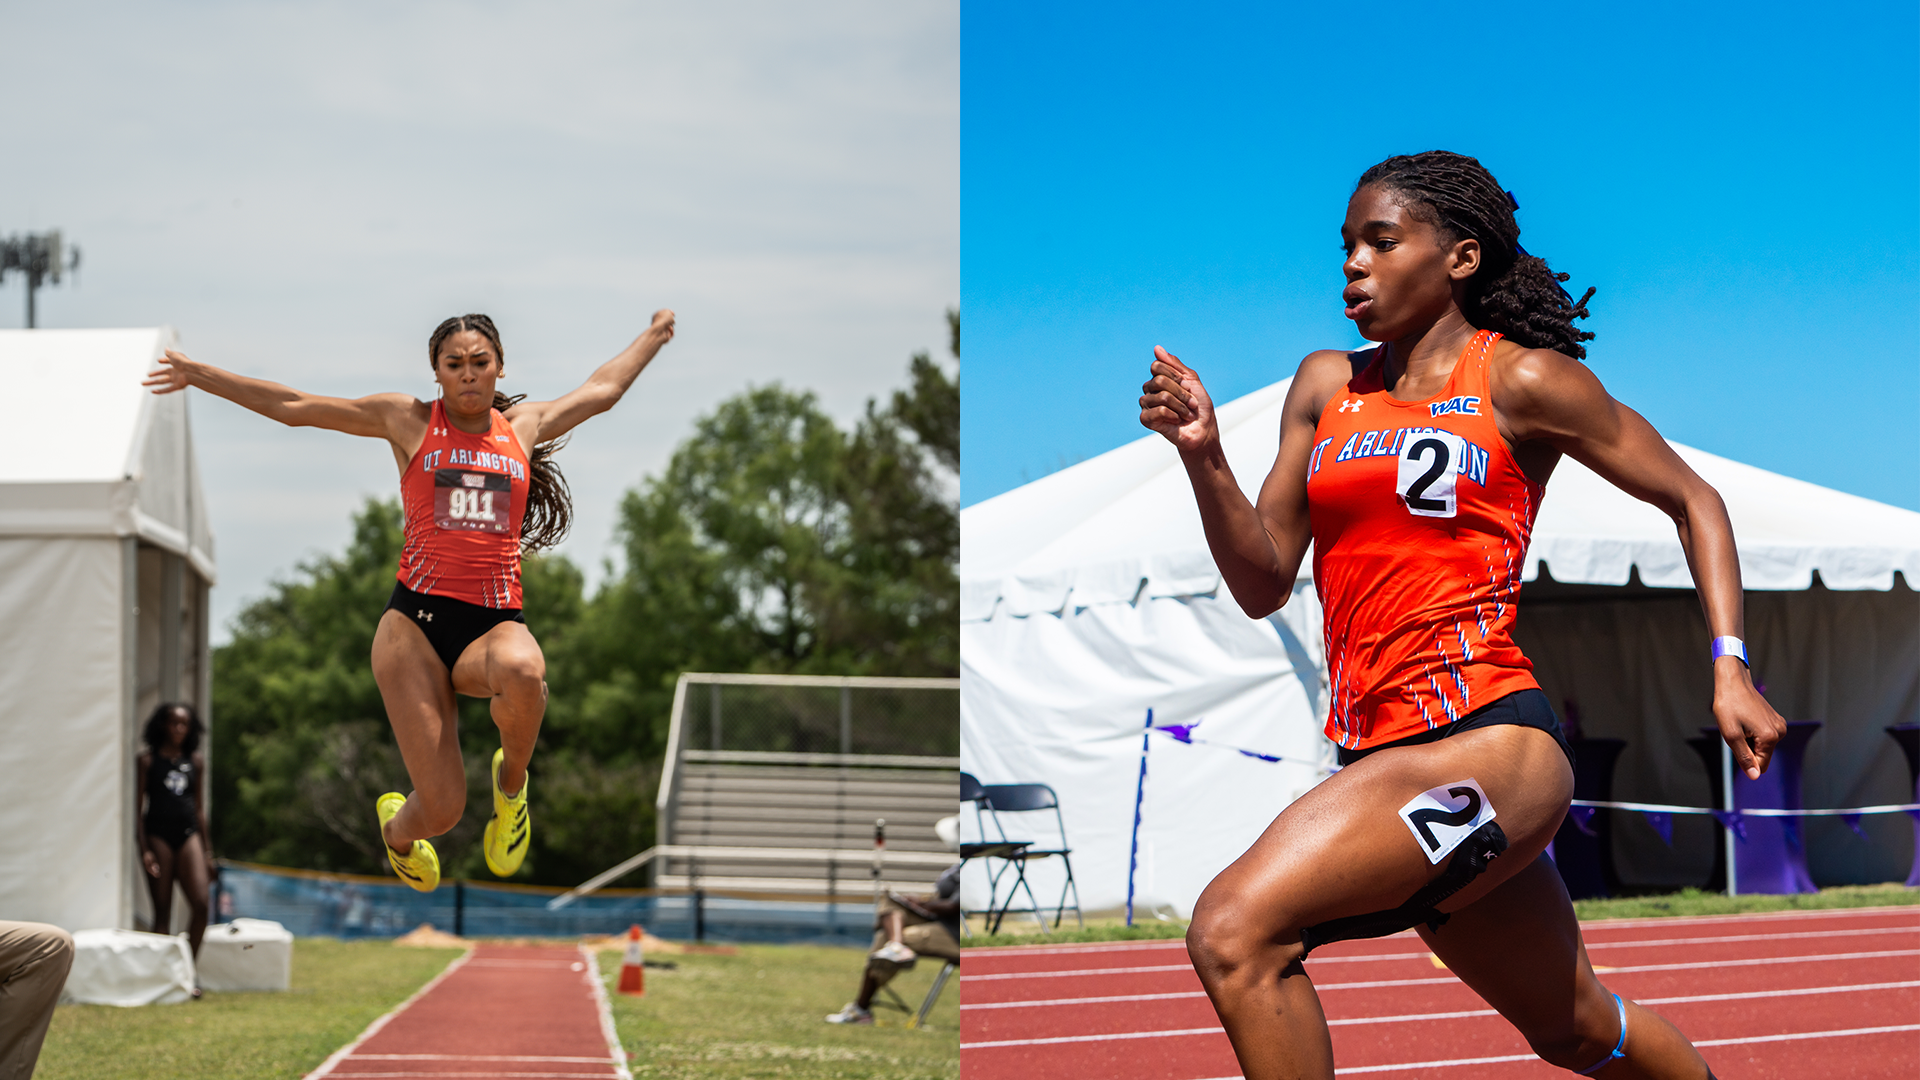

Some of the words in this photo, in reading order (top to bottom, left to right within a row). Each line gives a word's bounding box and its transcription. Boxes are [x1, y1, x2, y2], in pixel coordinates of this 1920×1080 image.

[1428, 396, 1481, 418] WAC
[424, 449, 442, 472] UT
[449, 448, 525, 482] ARLINGTON
[1336, 427, 1489, 488] ARLION
[1405, 438, 1450, 511] 2
[449, 488, 496, 521] 911
[1407, 786, 1482, 853] 2
